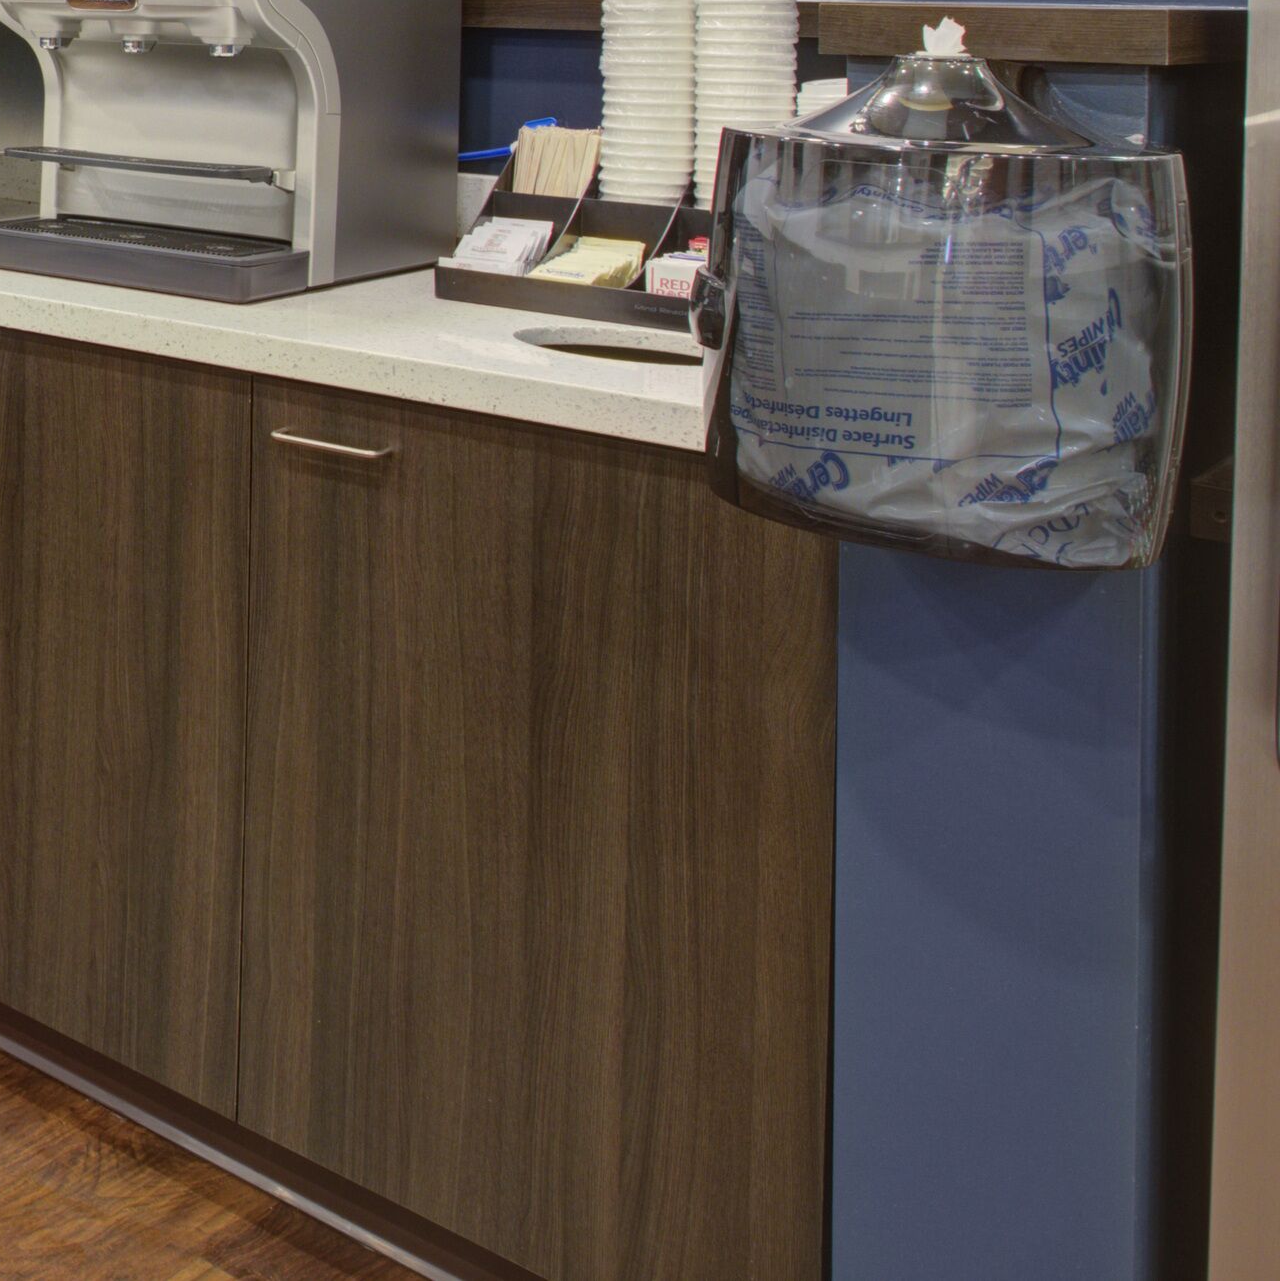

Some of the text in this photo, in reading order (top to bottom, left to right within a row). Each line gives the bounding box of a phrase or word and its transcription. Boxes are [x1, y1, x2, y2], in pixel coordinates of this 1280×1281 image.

[660, 278, 691, 291] RED
[826, 406, 913, 427] Lingettes
[842, 429, 916, 449] Surface
